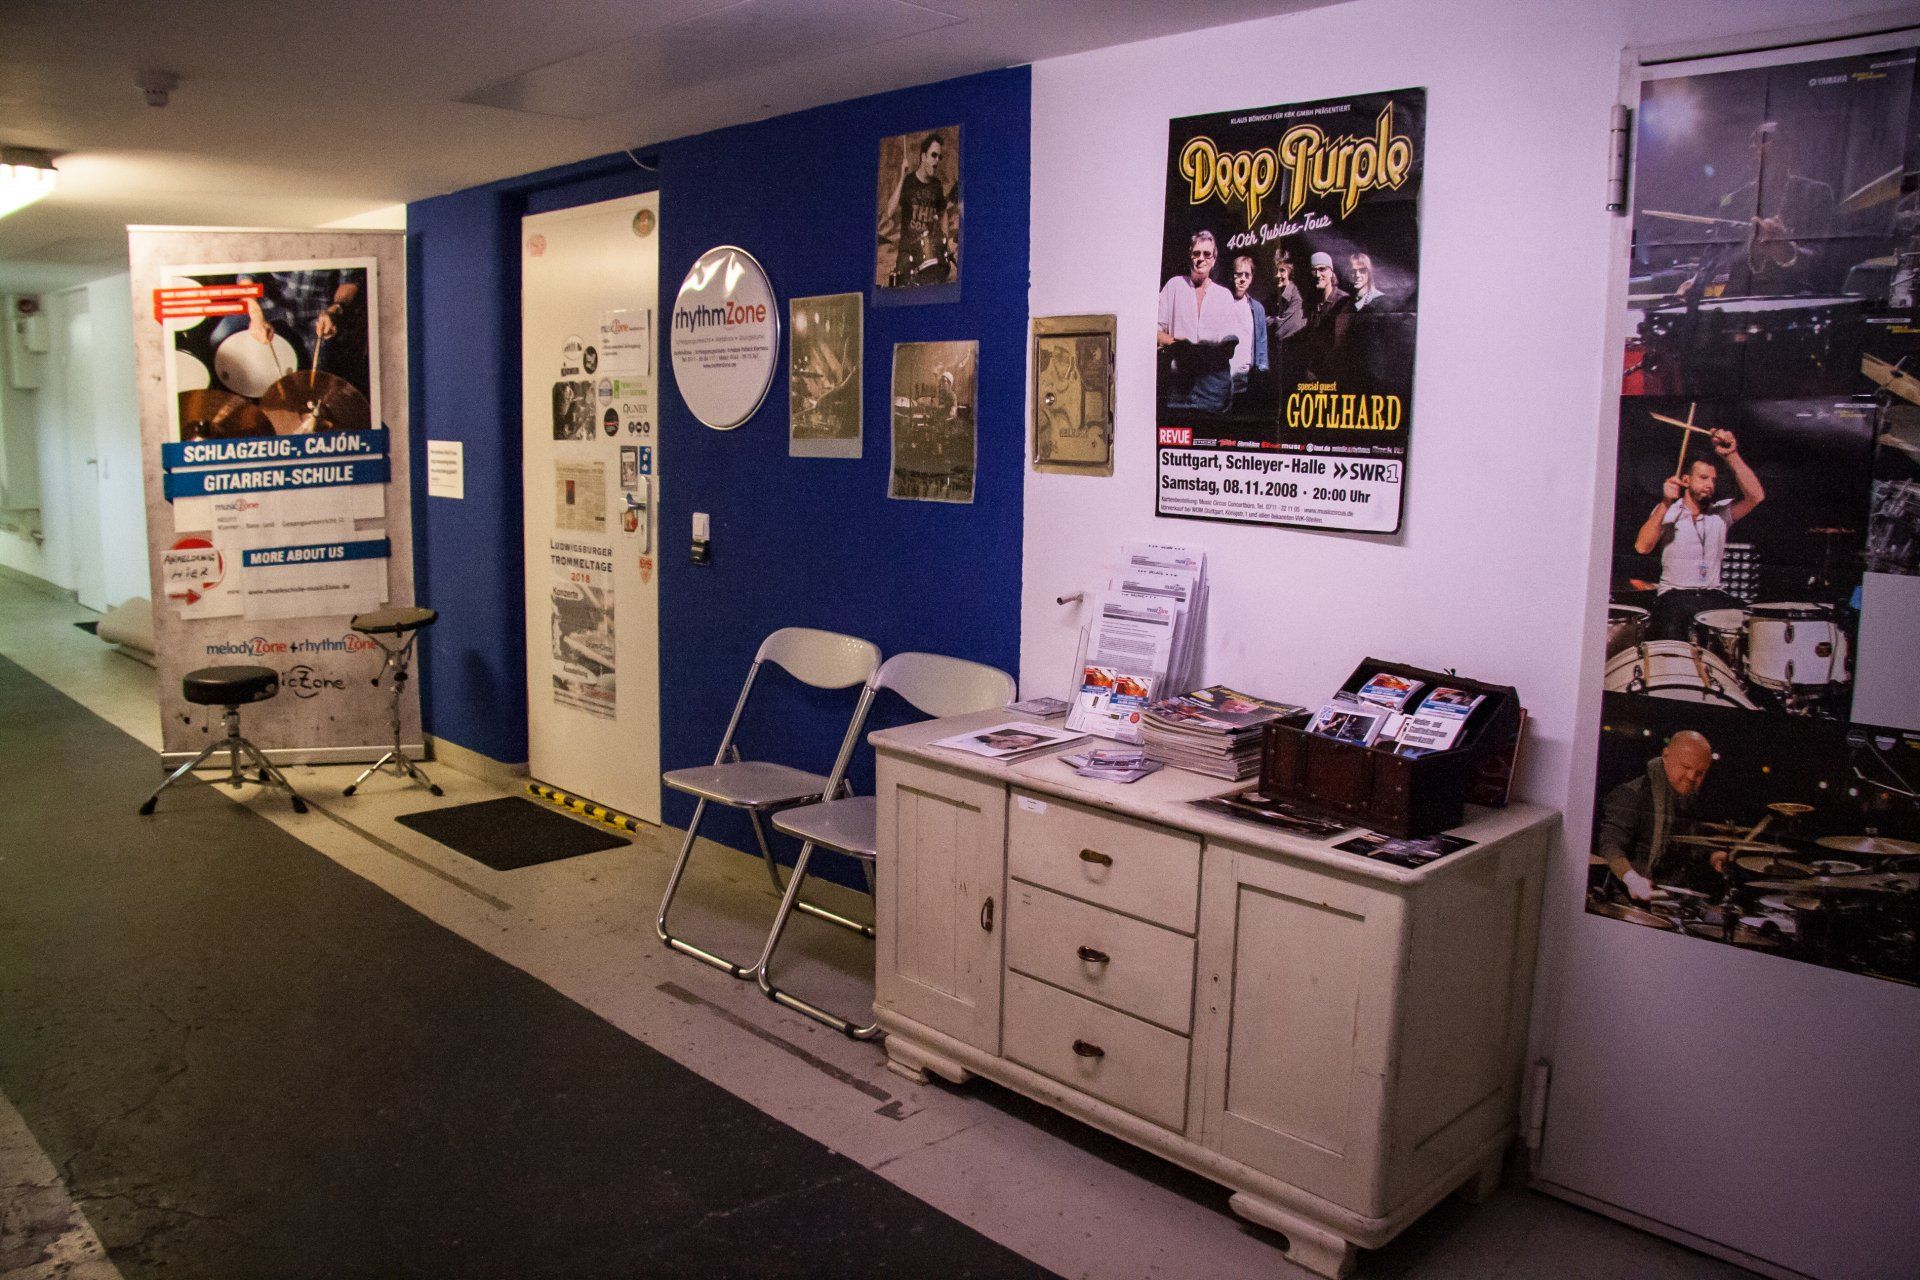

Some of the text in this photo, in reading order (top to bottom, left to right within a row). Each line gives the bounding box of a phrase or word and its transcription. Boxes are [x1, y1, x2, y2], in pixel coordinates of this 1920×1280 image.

[1230, 116, 1248, 125] KLAUS
[1273, 112, 1283, 120] FÜR
[1296, 109, 1314, 117] GMBH
[1314, 104, 1351, 116] PRÄSENTIERT
[1179, 102, 1413, 229] Deep Purple
[1227, 211, 1332, 250] 40th Jubilee-Tour
[675, 301, 767, 333] rhythmZone
[1297, 381, 1337, 394] special guest
[1286, 393, 1402, 431] GOTTHARD
[183, 432, 371, 463] SCHLAGZEUG-, CAJÓN-,
[1160, 429, 1190, 445] REVUE
[1161, 451, 1326, 475] Stuttgart, Schleyer-Halle
[1349, 462, 1399, 484] SWR1
[203, 465, 355, 492] GITARREN-SCHULE
[1161, 474, 1371, 504] Samstag, 08.11.2008 20:00 Uhr
[250, 546, 345, 565] MORE ABOUT US
[550, 539, 613, 557] LUDWIGSBURGER
[550, 554, 613, 573] TROMMELTAGE
[570, 572, 591, 584] 2018
[206, 638, 287, 656] melodyZone
[298, 636, 378, 655] rhythmZone
